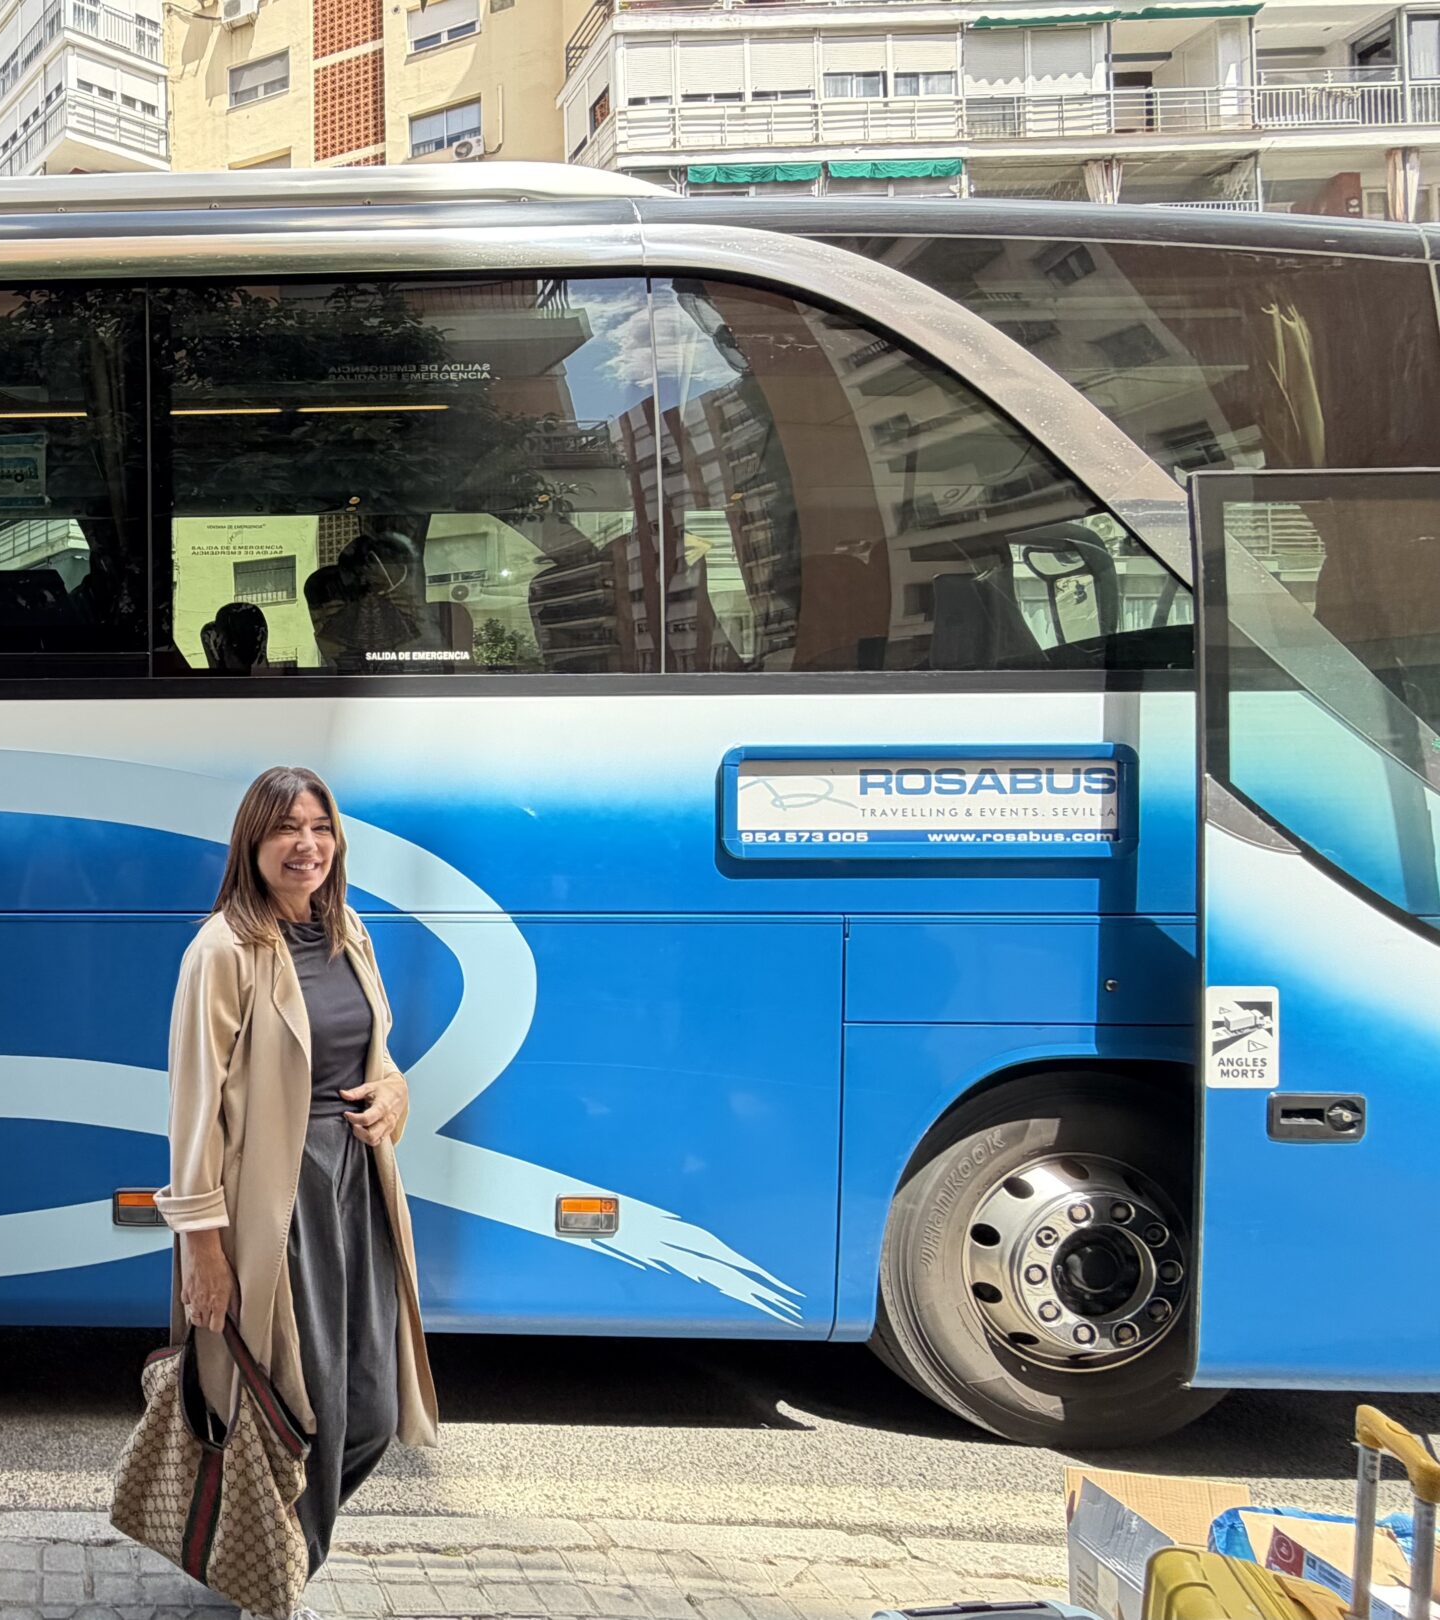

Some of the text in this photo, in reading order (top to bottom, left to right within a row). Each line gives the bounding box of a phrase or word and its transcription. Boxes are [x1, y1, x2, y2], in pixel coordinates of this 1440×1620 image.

[380, 373, 398, 381] DE
[401, 372, 491, 380] EMERGENCIA
[365, 650, 470, 660] SALIDA DE EMERGENCIA
[859, 767, 1116, 795] ROSABUS
[860, 807, 959, 817] TRAVELLING
[964, 807, 973, 817] &
[740, 831, 869, 843] 954 573 005
[927, 831, 1114, 842] www.rosabus.com
[1217, 1057, 1268, 1068] ANGLES
[1220, 1068, 1265, 1079] MORTS
